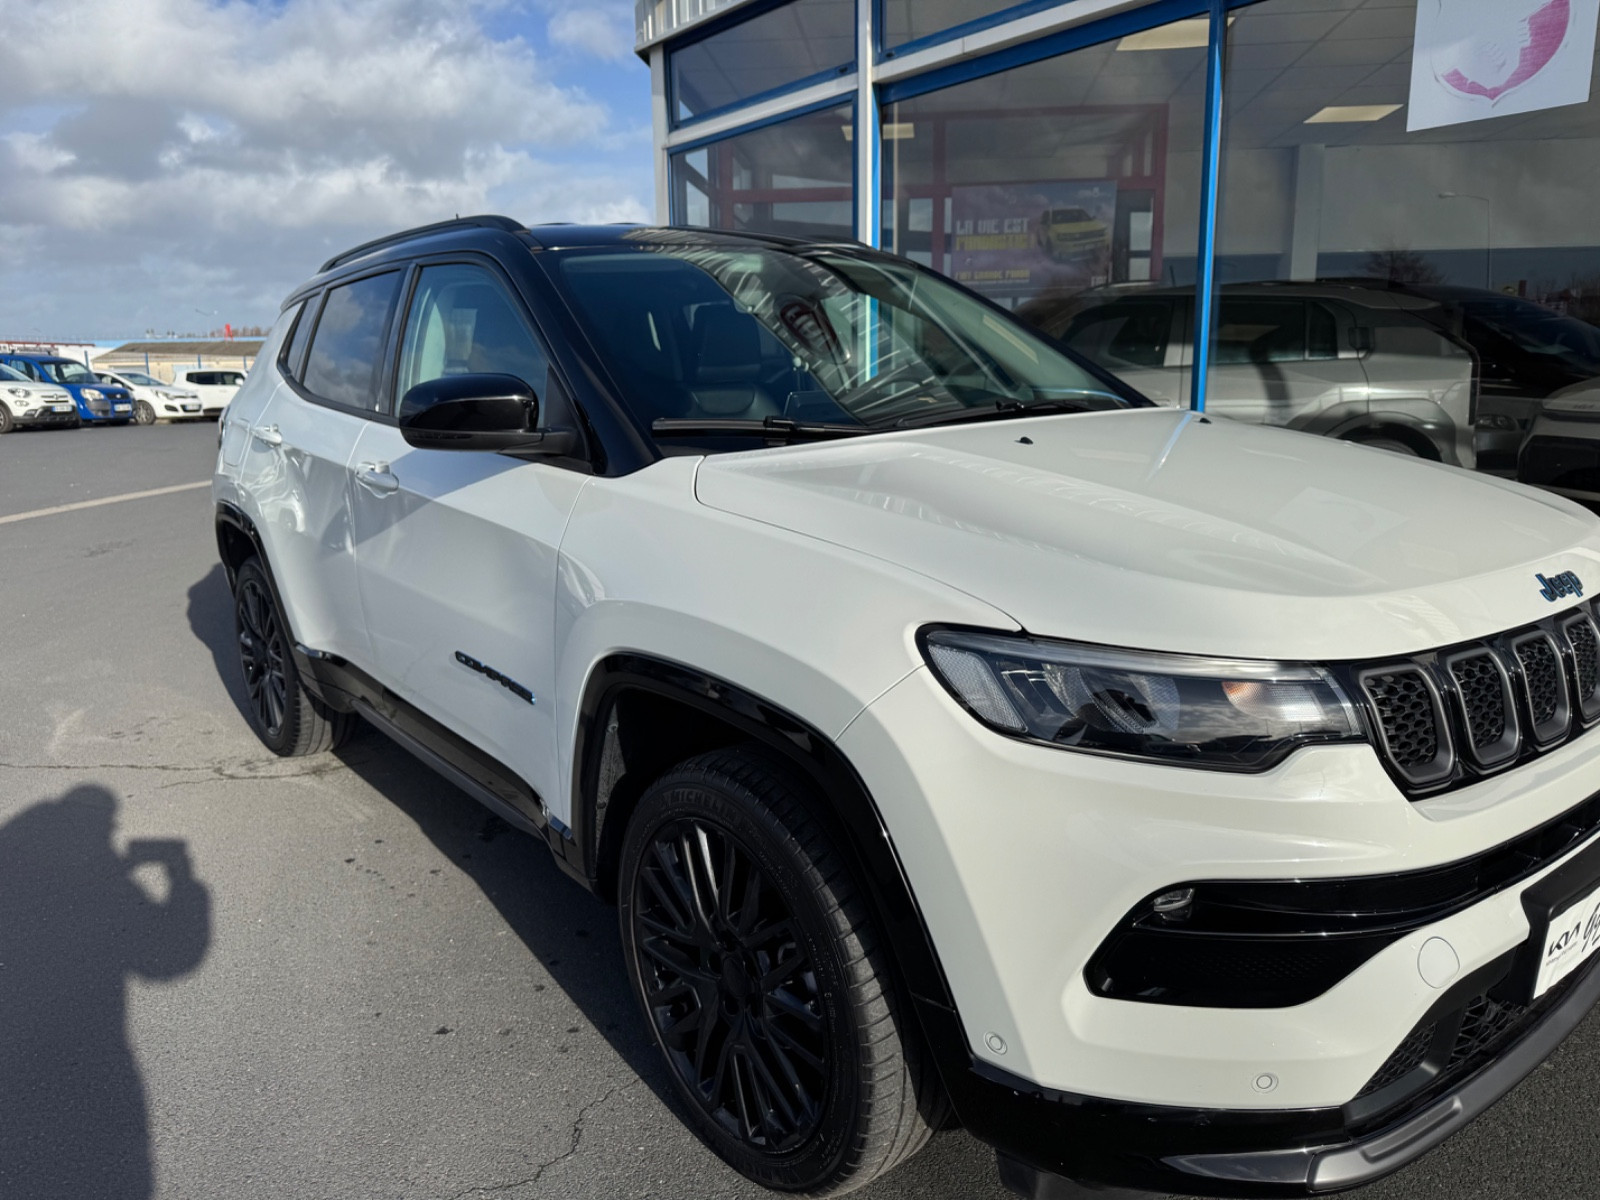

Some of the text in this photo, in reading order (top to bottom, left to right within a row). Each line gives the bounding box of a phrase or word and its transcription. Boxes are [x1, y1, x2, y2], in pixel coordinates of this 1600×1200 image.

[956, 218, 1029, 234] LA VIE EST
[1535, 570, 1583, 602] Jeep
